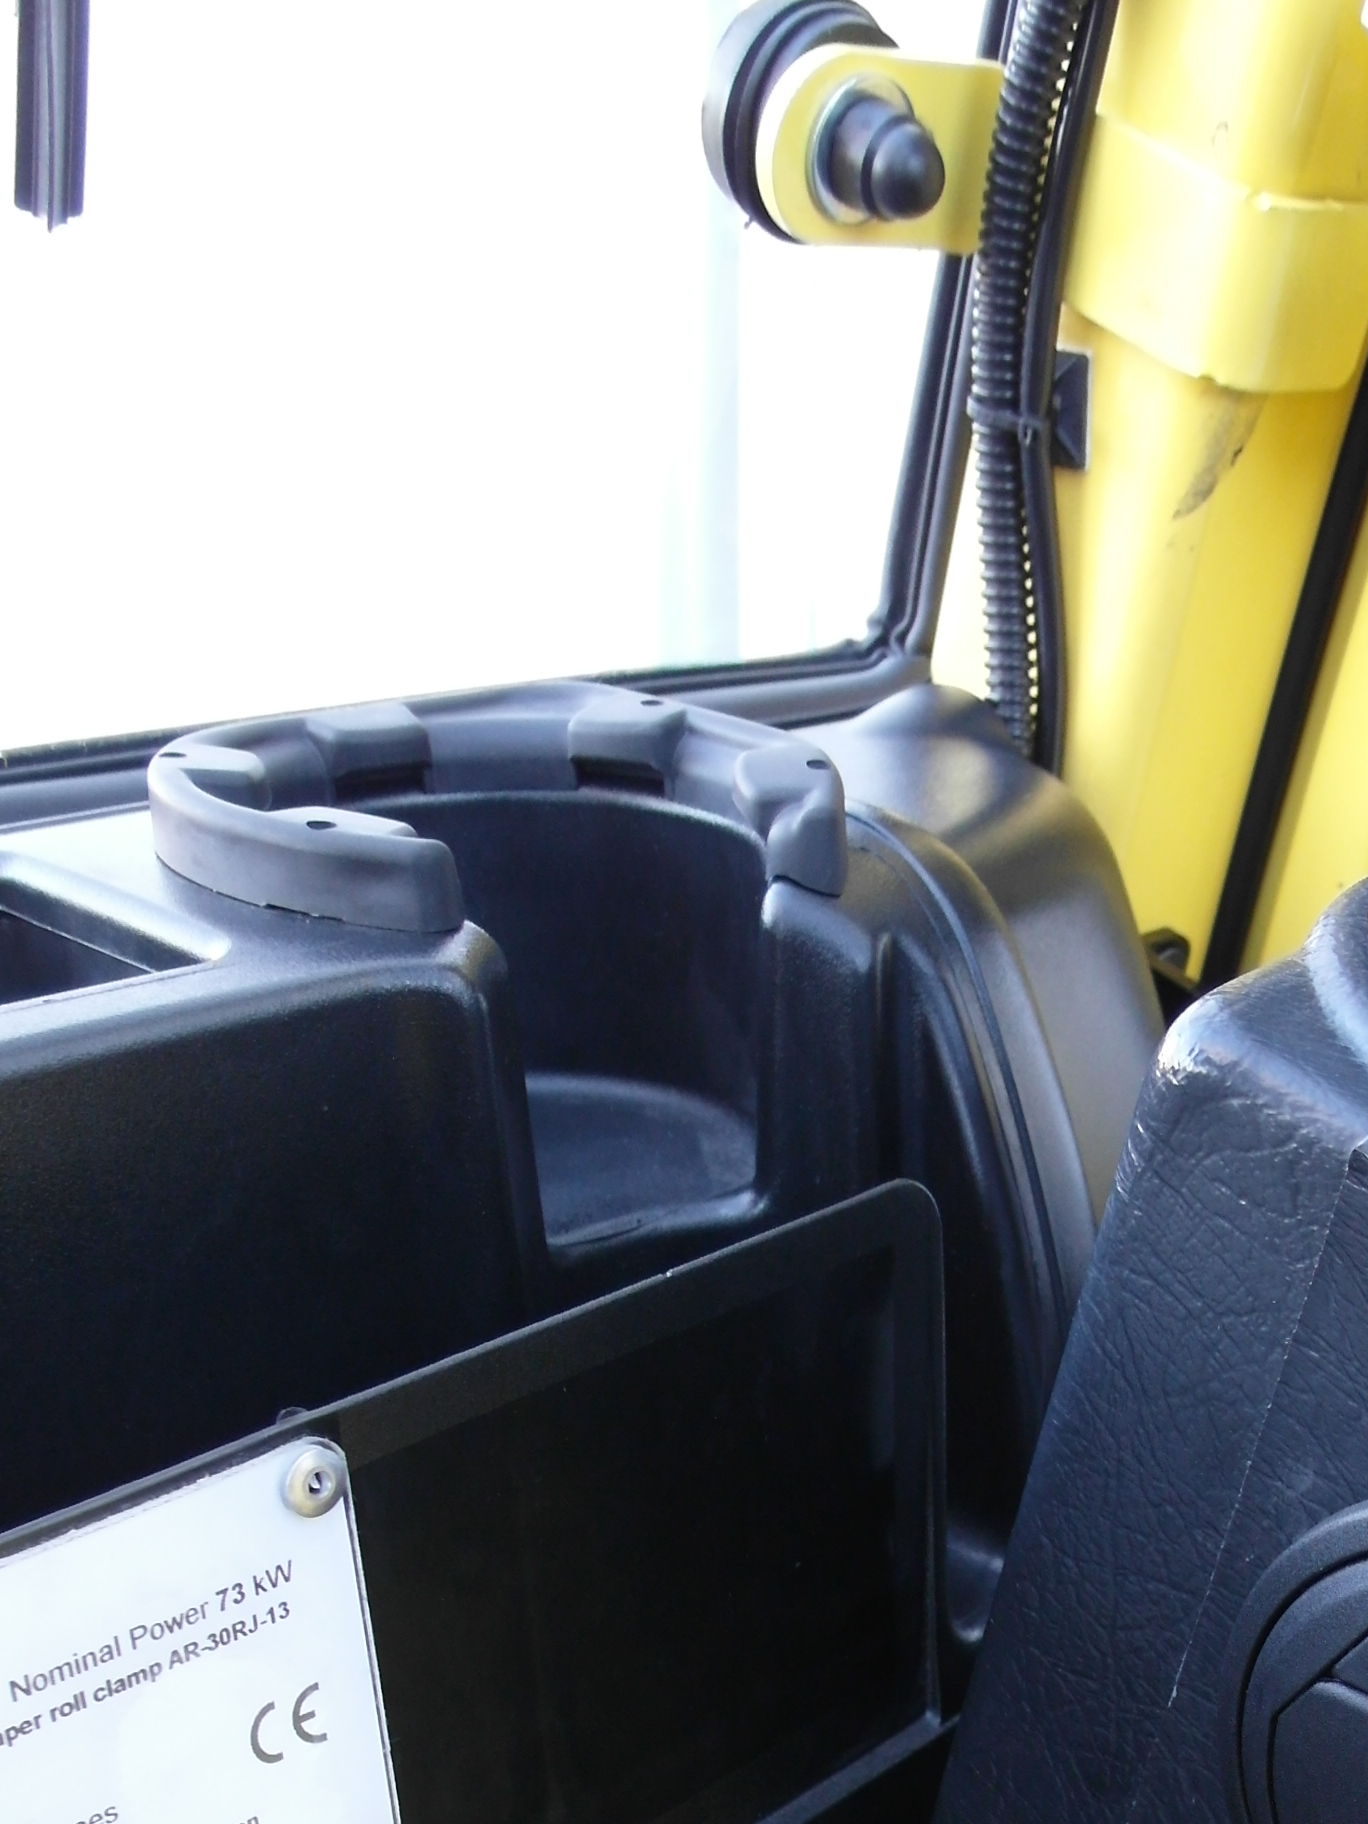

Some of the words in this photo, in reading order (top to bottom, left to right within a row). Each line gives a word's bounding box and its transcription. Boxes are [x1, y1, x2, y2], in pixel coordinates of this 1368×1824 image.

[0, 1714, 42, 1747] per
[49, 1691, 88, 1723] roll
[93, 1661, 164, 1702] clamp
[168, 1601, 291, 1670] AR-30RJ-13
[9, 1635, 123, 1702] Nominal
[129, 1601, 210, 1650] Power
[215, 1582, 246, 1611] 73
[252, 1559, 293, 1596] kW
